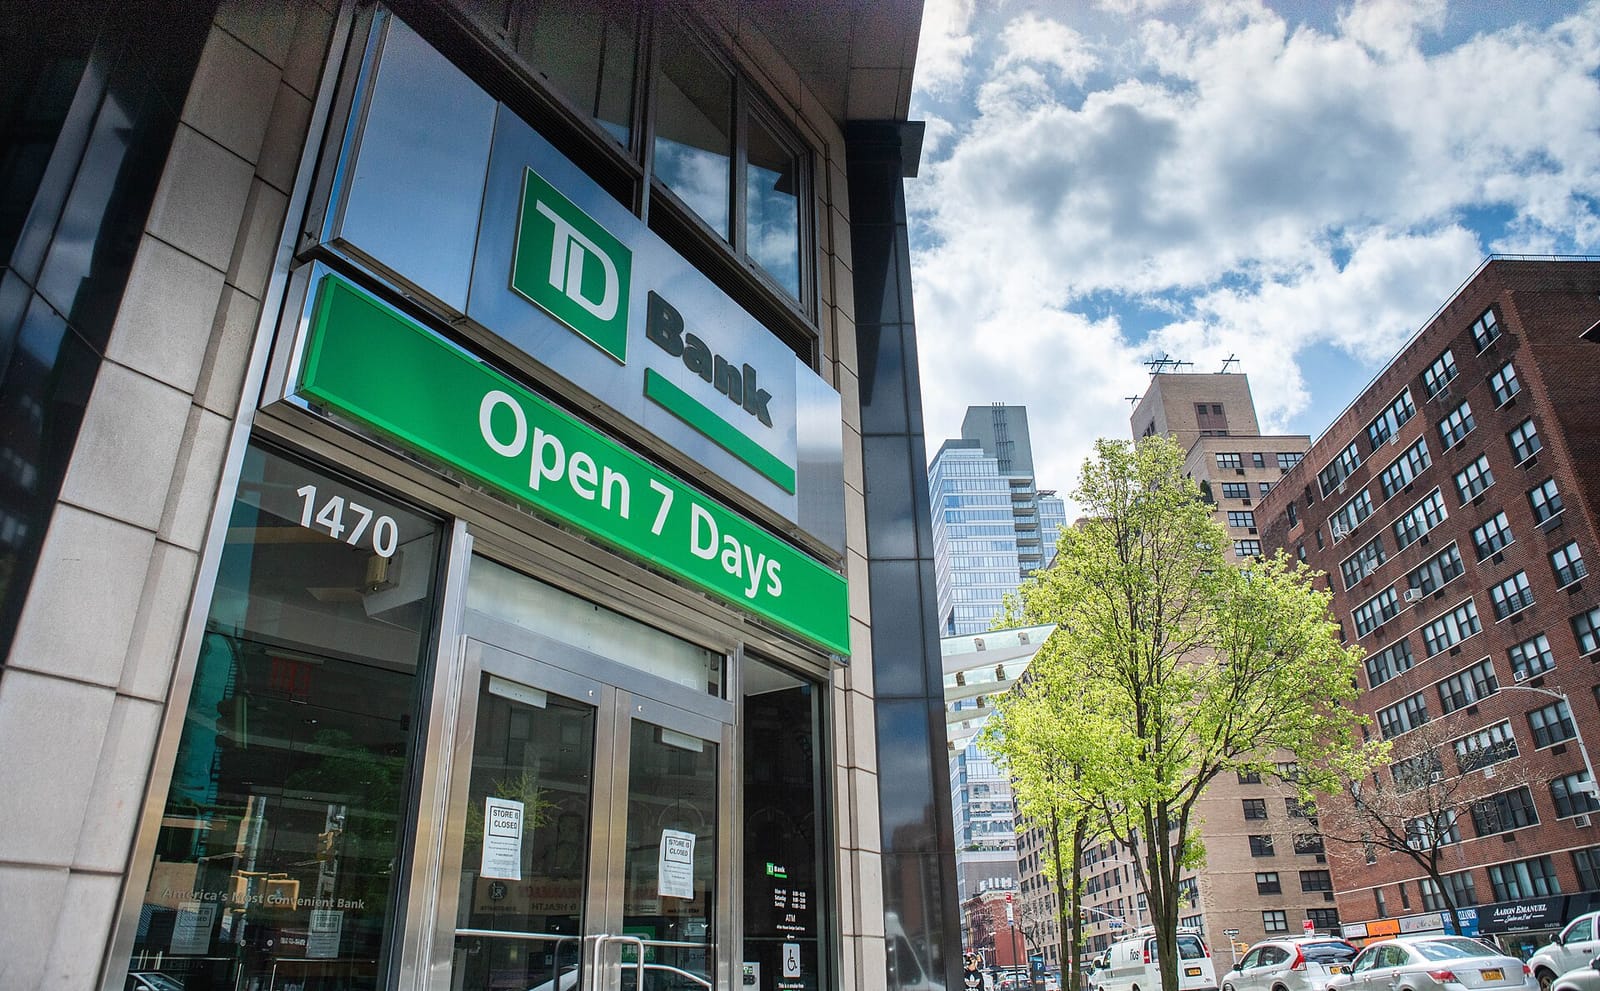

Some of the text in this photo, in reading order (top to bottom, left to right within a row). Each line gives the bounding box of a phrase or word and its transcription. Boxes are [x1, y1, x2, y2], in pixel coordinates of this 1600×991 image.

[535, 199, 773, 429] TD Bank
[479, 390, 783, 599] Open 7 Days
[296, 484, 399, 558] 1470
[493, 809, 514, 819] STORE
[493, 820, 518, 830] CLOSED
[669, 847, 689, 857] CLOSED
[161, 888, 366, 910] America's Most Convenient Bank
[1493, 904, 1548, 917] AARON EMANUEL
